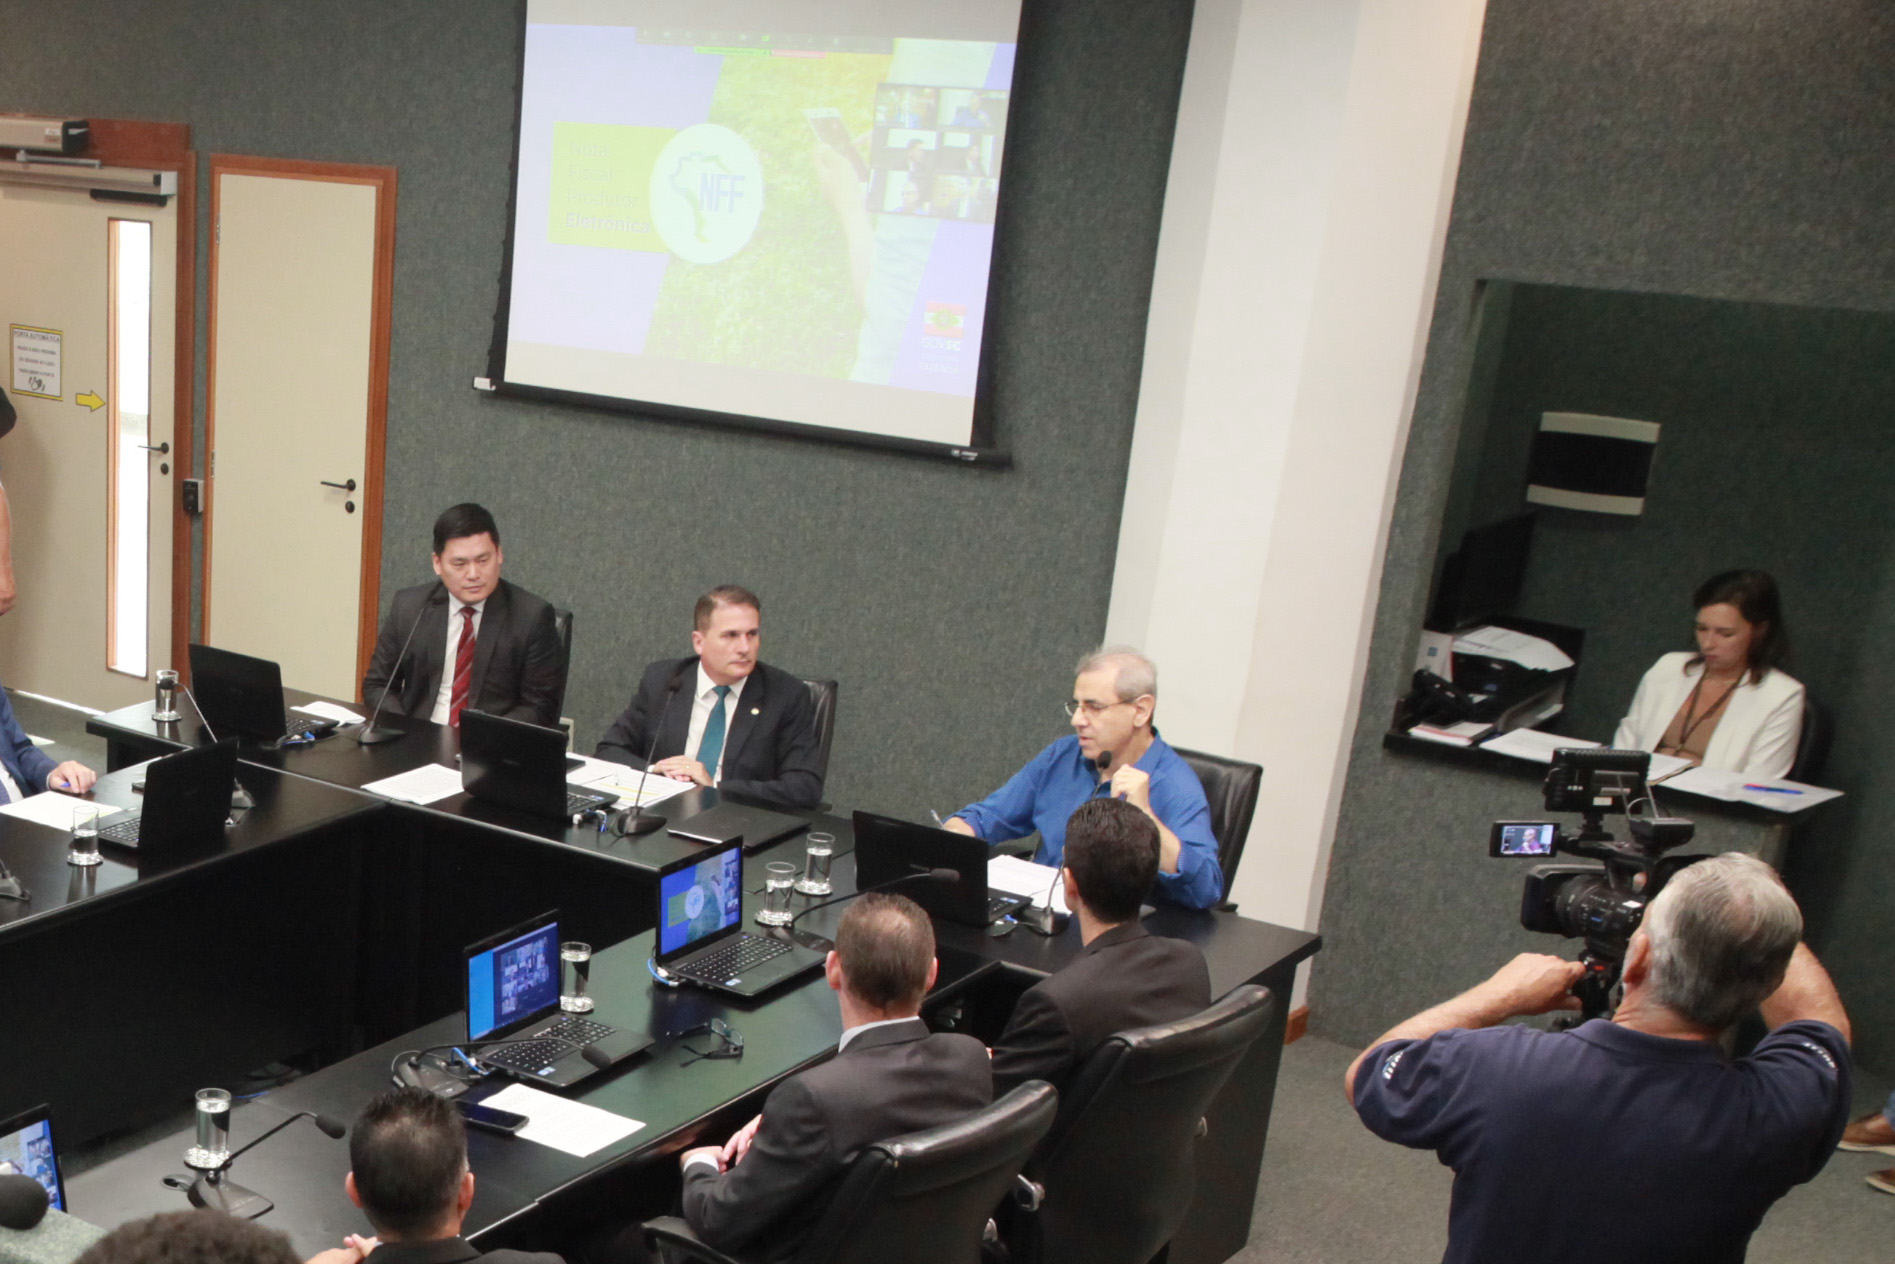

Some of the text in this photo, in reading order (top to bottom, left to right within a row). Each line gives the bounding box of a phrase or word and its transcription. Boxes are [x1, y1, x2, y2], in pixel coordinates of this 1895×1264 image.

[569, 141, 608, 158] Nota
[568, 165, 613, 182] Fiscal
[567, 189, 638, 209] Produtor
[699, 172, 745, 214] NFF
[566, 212, 650, 234] Eletrônica
